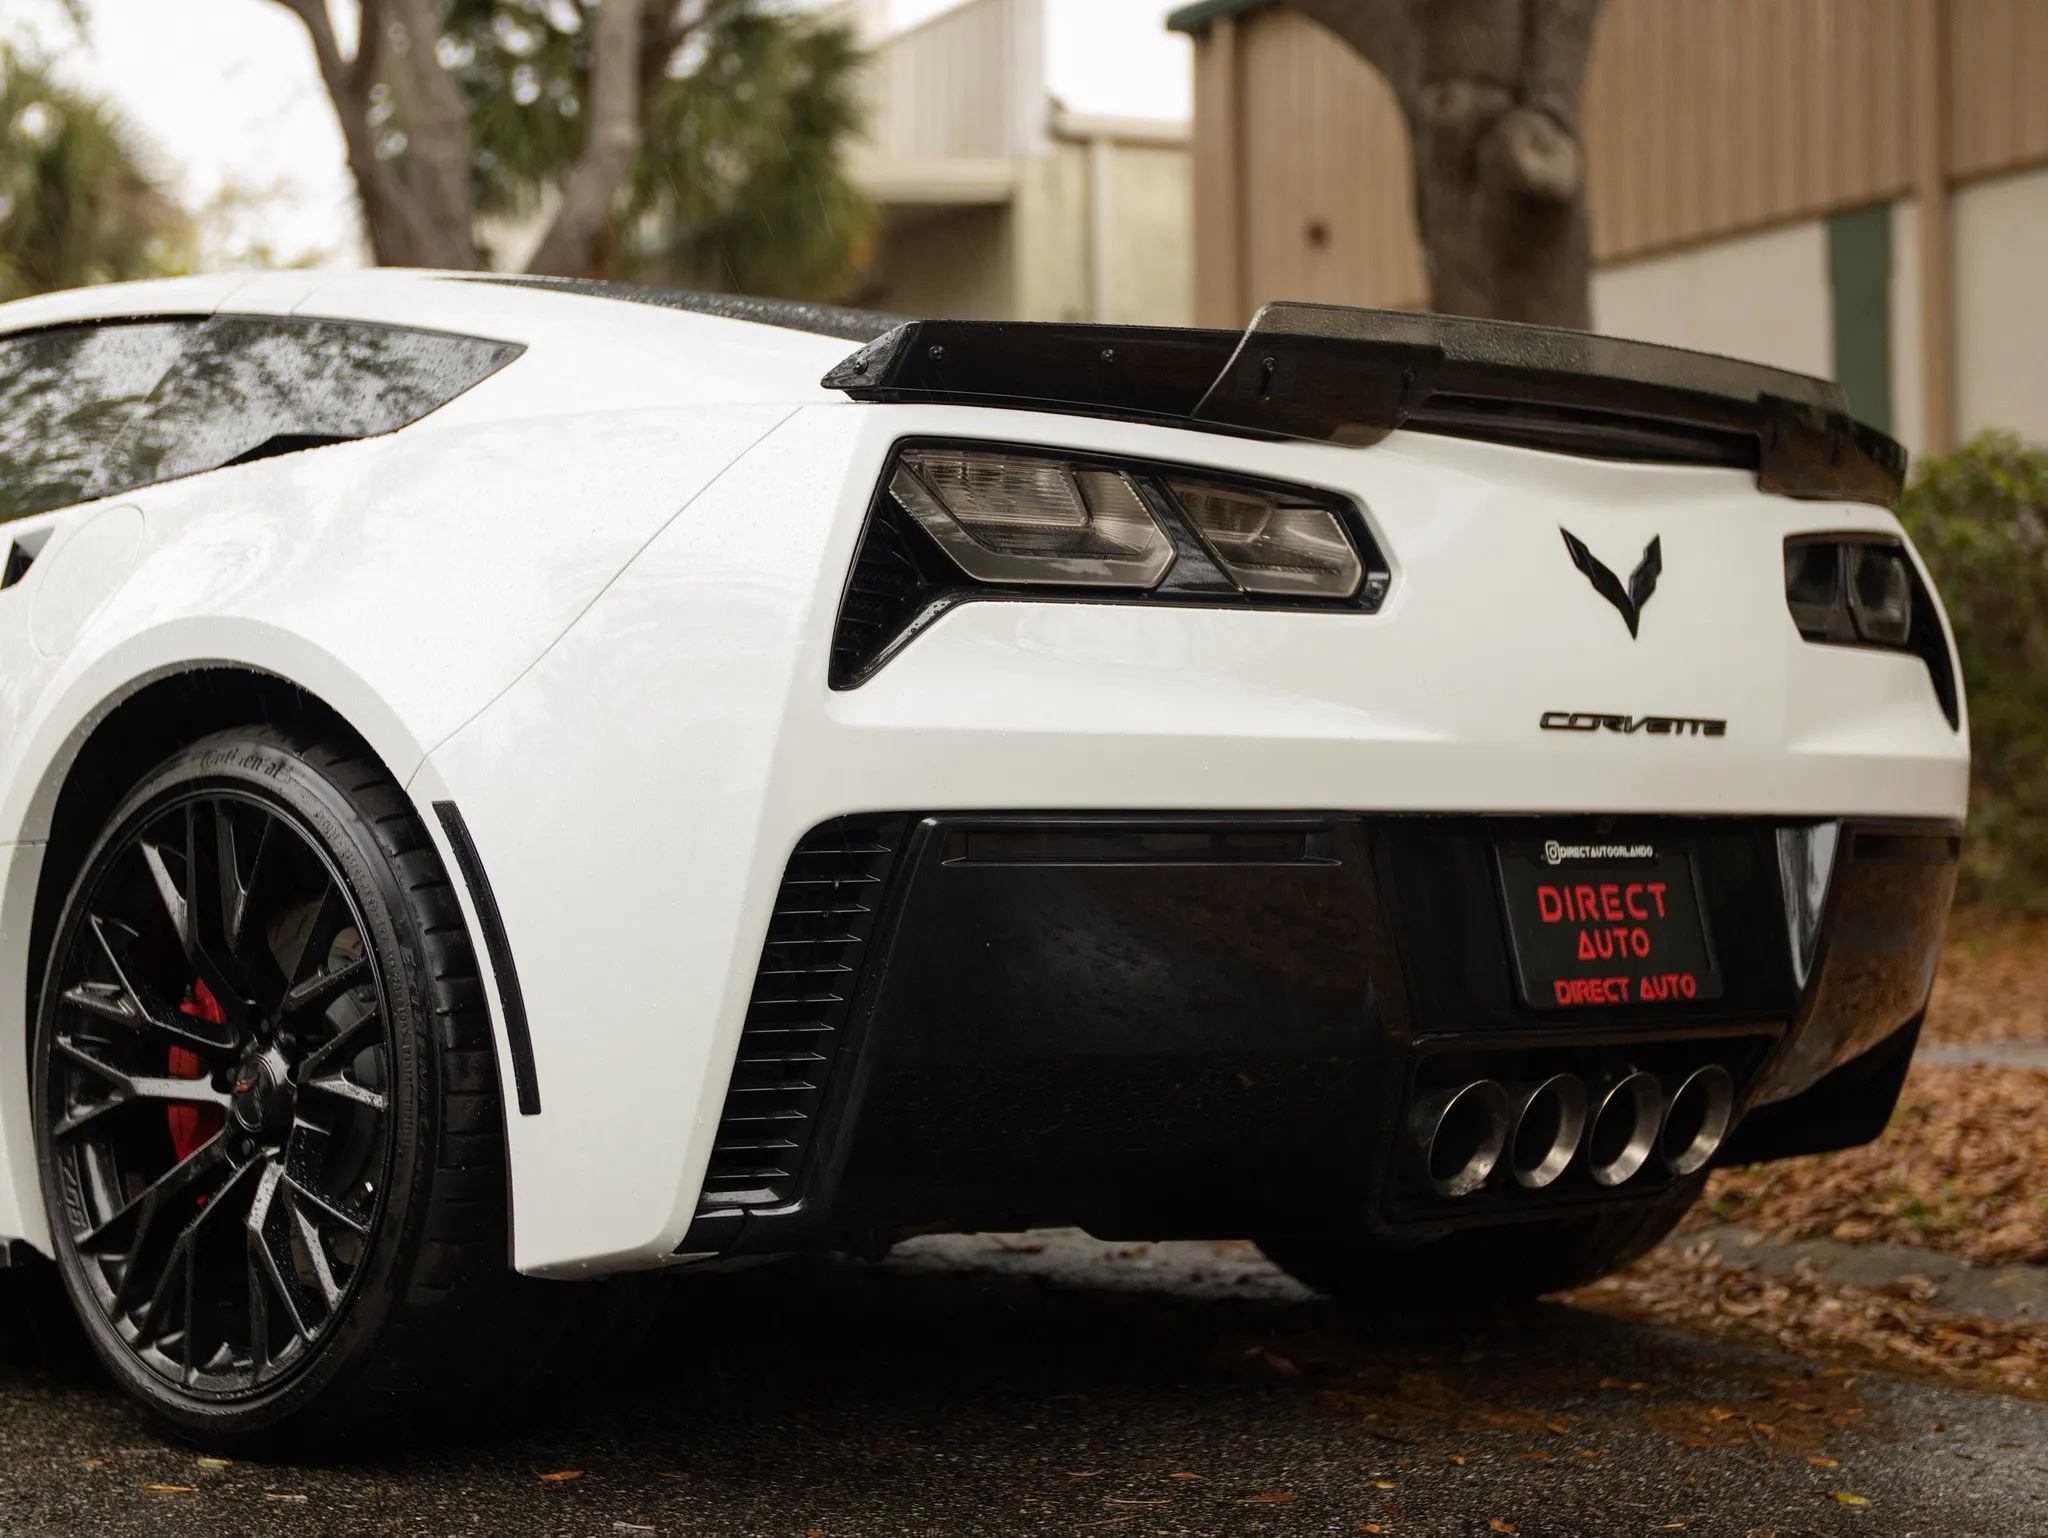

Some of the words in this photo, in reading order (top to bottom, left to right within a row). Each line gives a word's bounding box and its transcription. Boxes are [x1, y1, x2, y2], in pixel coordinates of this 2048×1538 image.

[1540, 712, 1726, 736] CORVETTE
[1536, 882, 1666, 923] DIRECT
[1577, 926, 1650, 960] AUTO
[1554, 976, 1630, 1005] DIRECT
[1640, 973, 1696, 1001] AUTO
